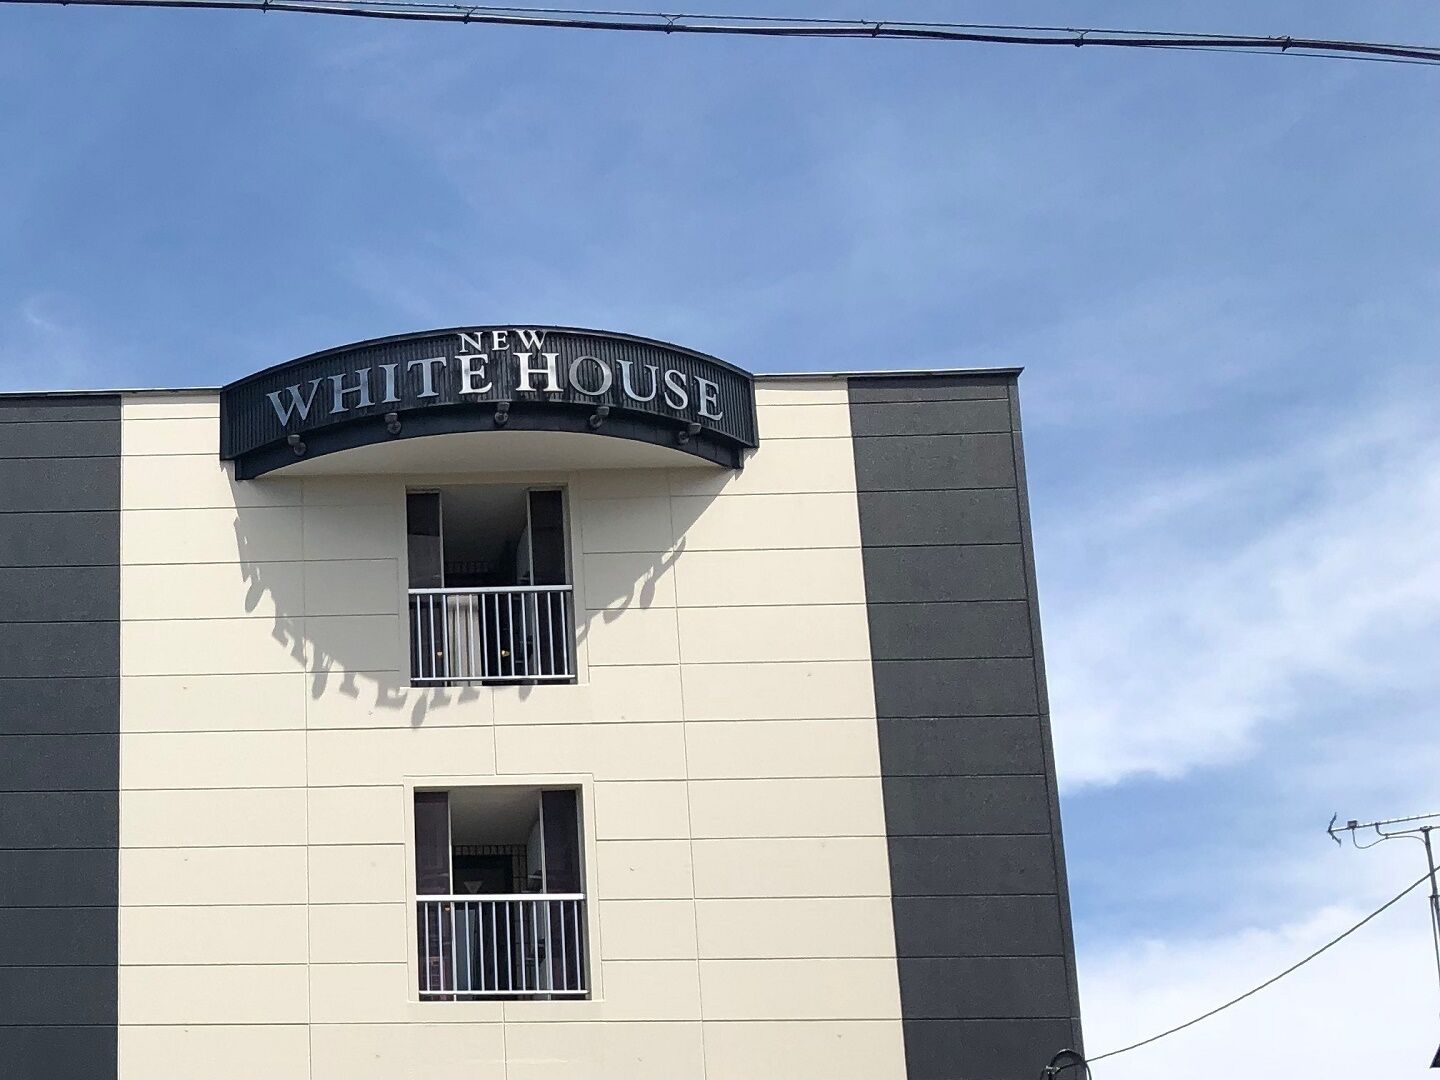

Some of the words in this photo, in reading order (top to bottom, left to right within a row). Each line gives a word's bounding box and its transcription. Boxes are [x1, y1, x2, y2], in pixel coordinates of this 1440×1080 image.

[457, 329, 548, 351] NEW
[266, 353, 493, 427] WHITE
[512, 352, 725, 422] HOUSE
